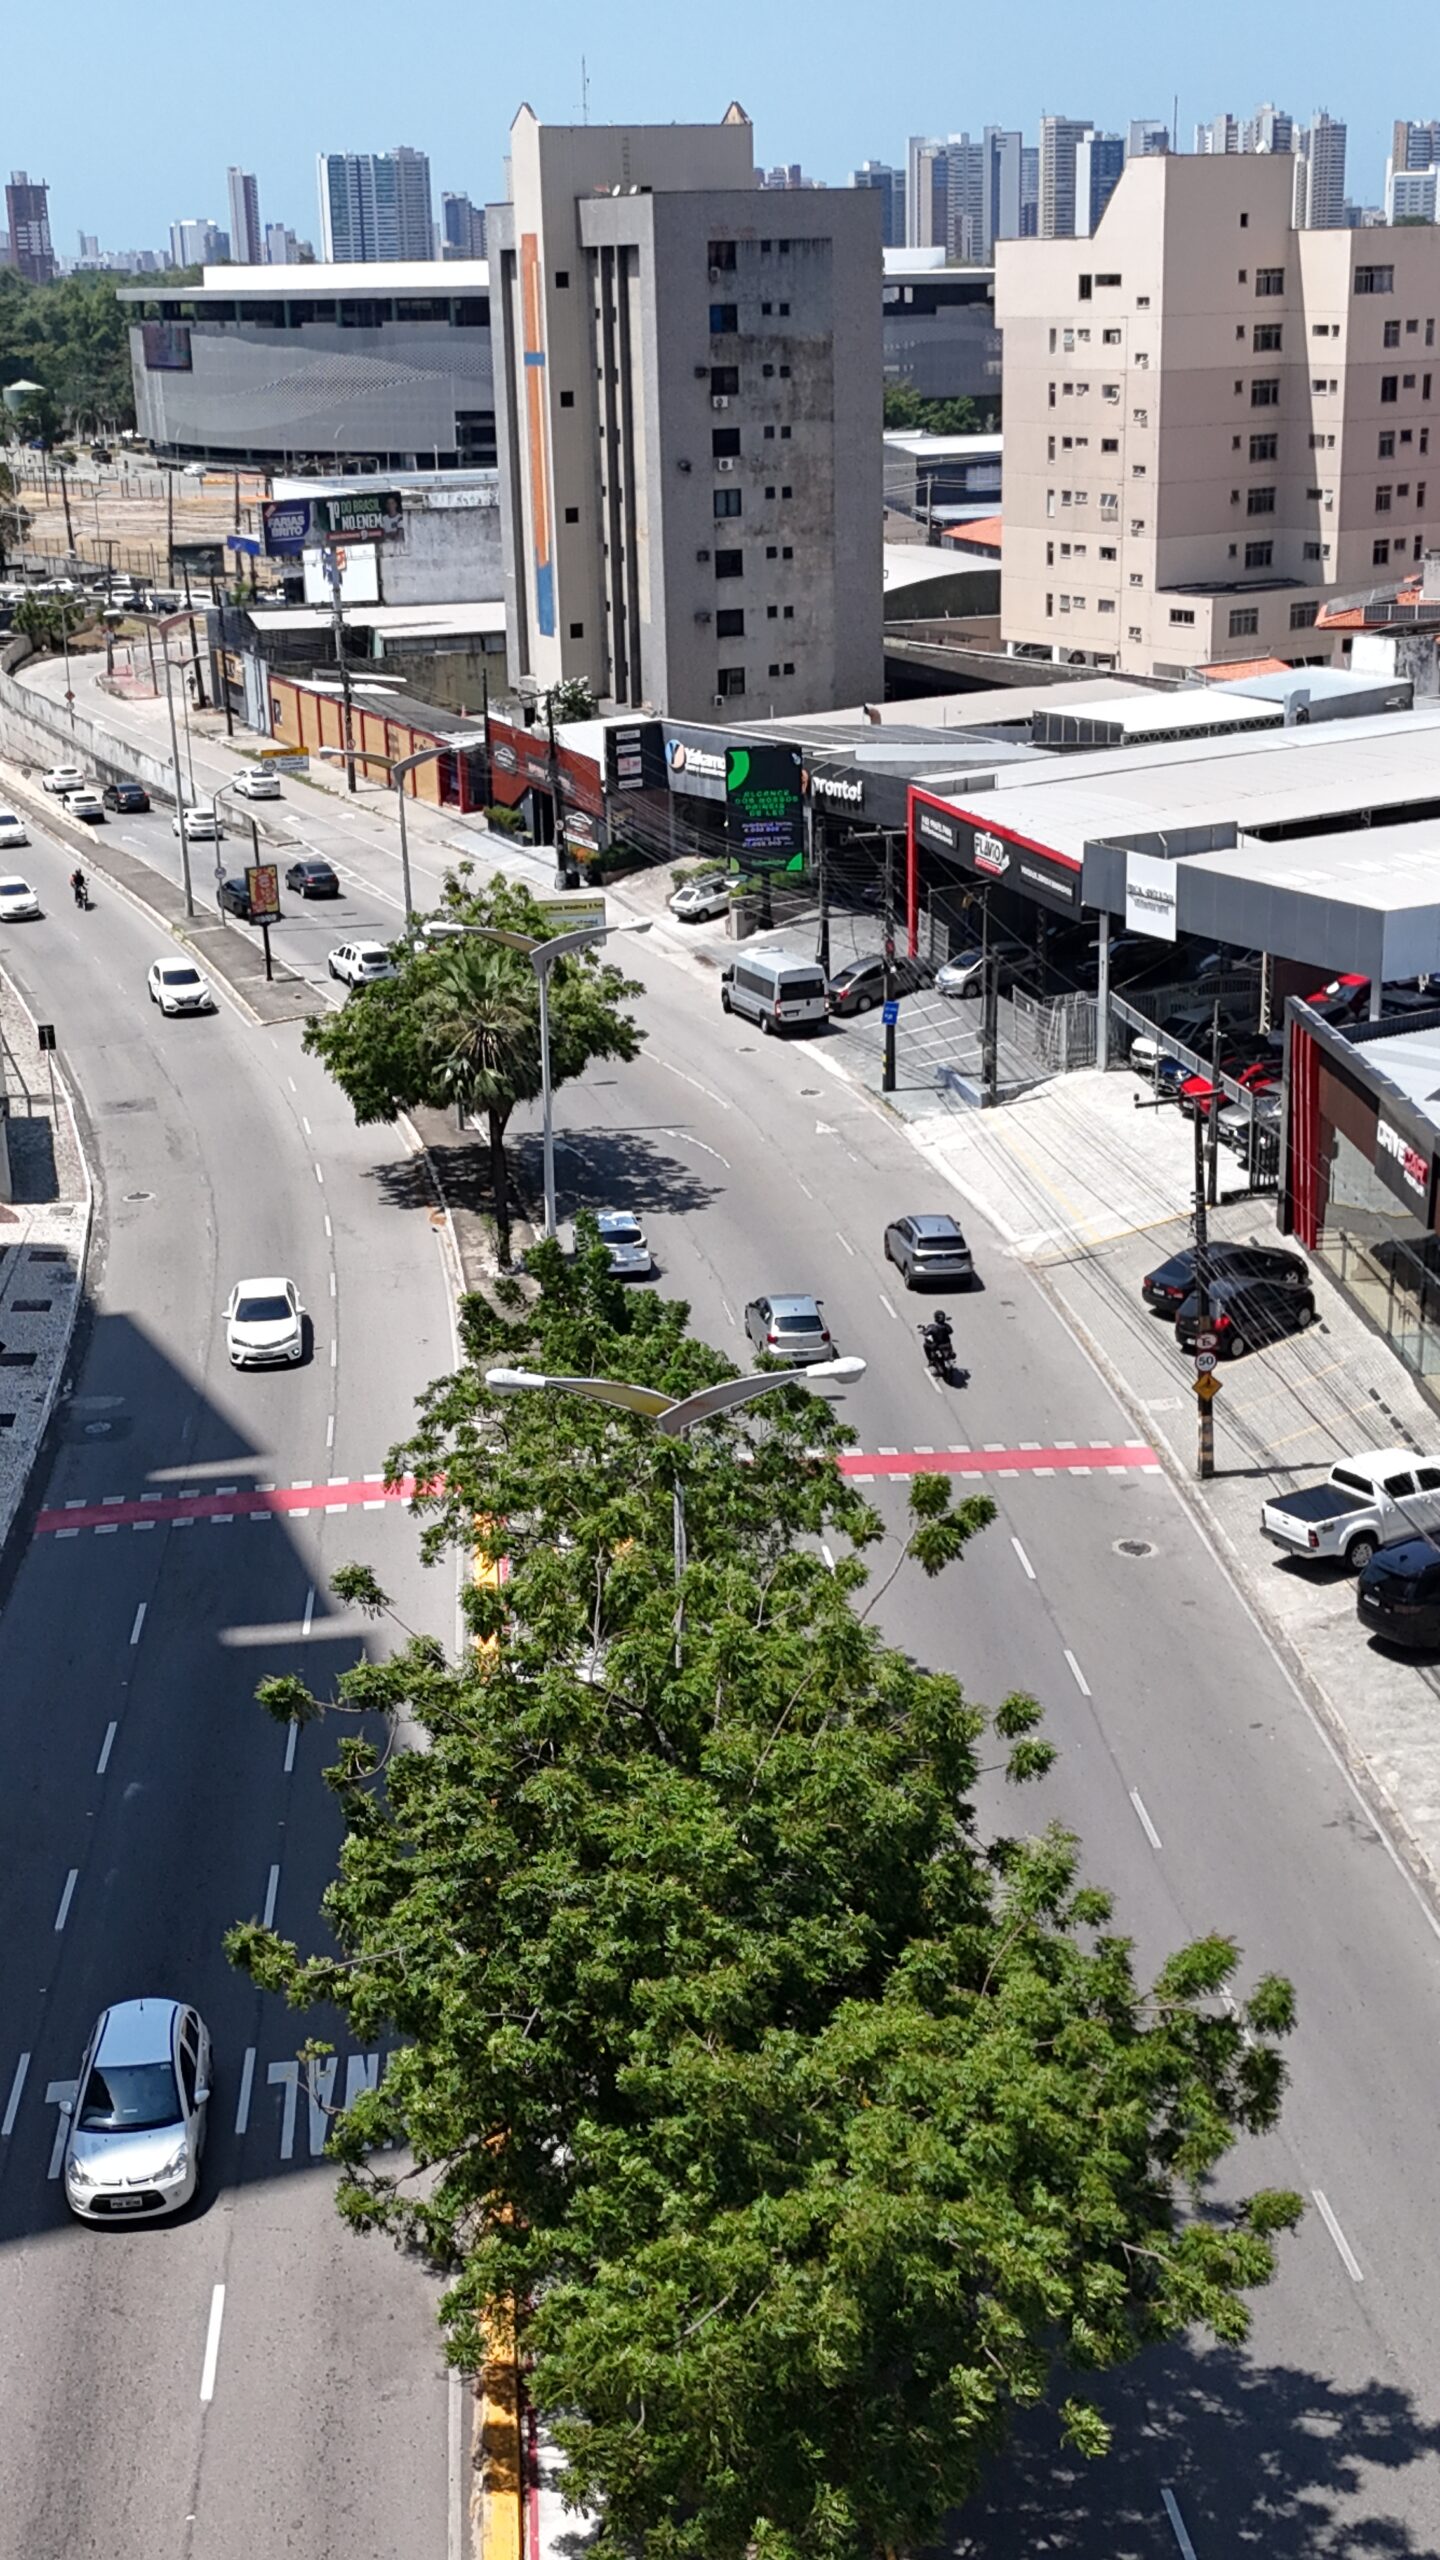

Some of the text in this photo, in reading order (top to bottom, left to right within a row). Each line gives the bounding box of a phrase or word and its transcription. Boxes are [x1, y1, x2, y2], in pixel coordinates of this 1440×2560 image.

[353, 498, 382, 513] BRASIL
[268, 515, 305, 528] FARIAS
[356, 513, 383, 529] ENEM
[271, 526, 303, 538] BRITO
[1198, 1355, 1214, 1366] 50
